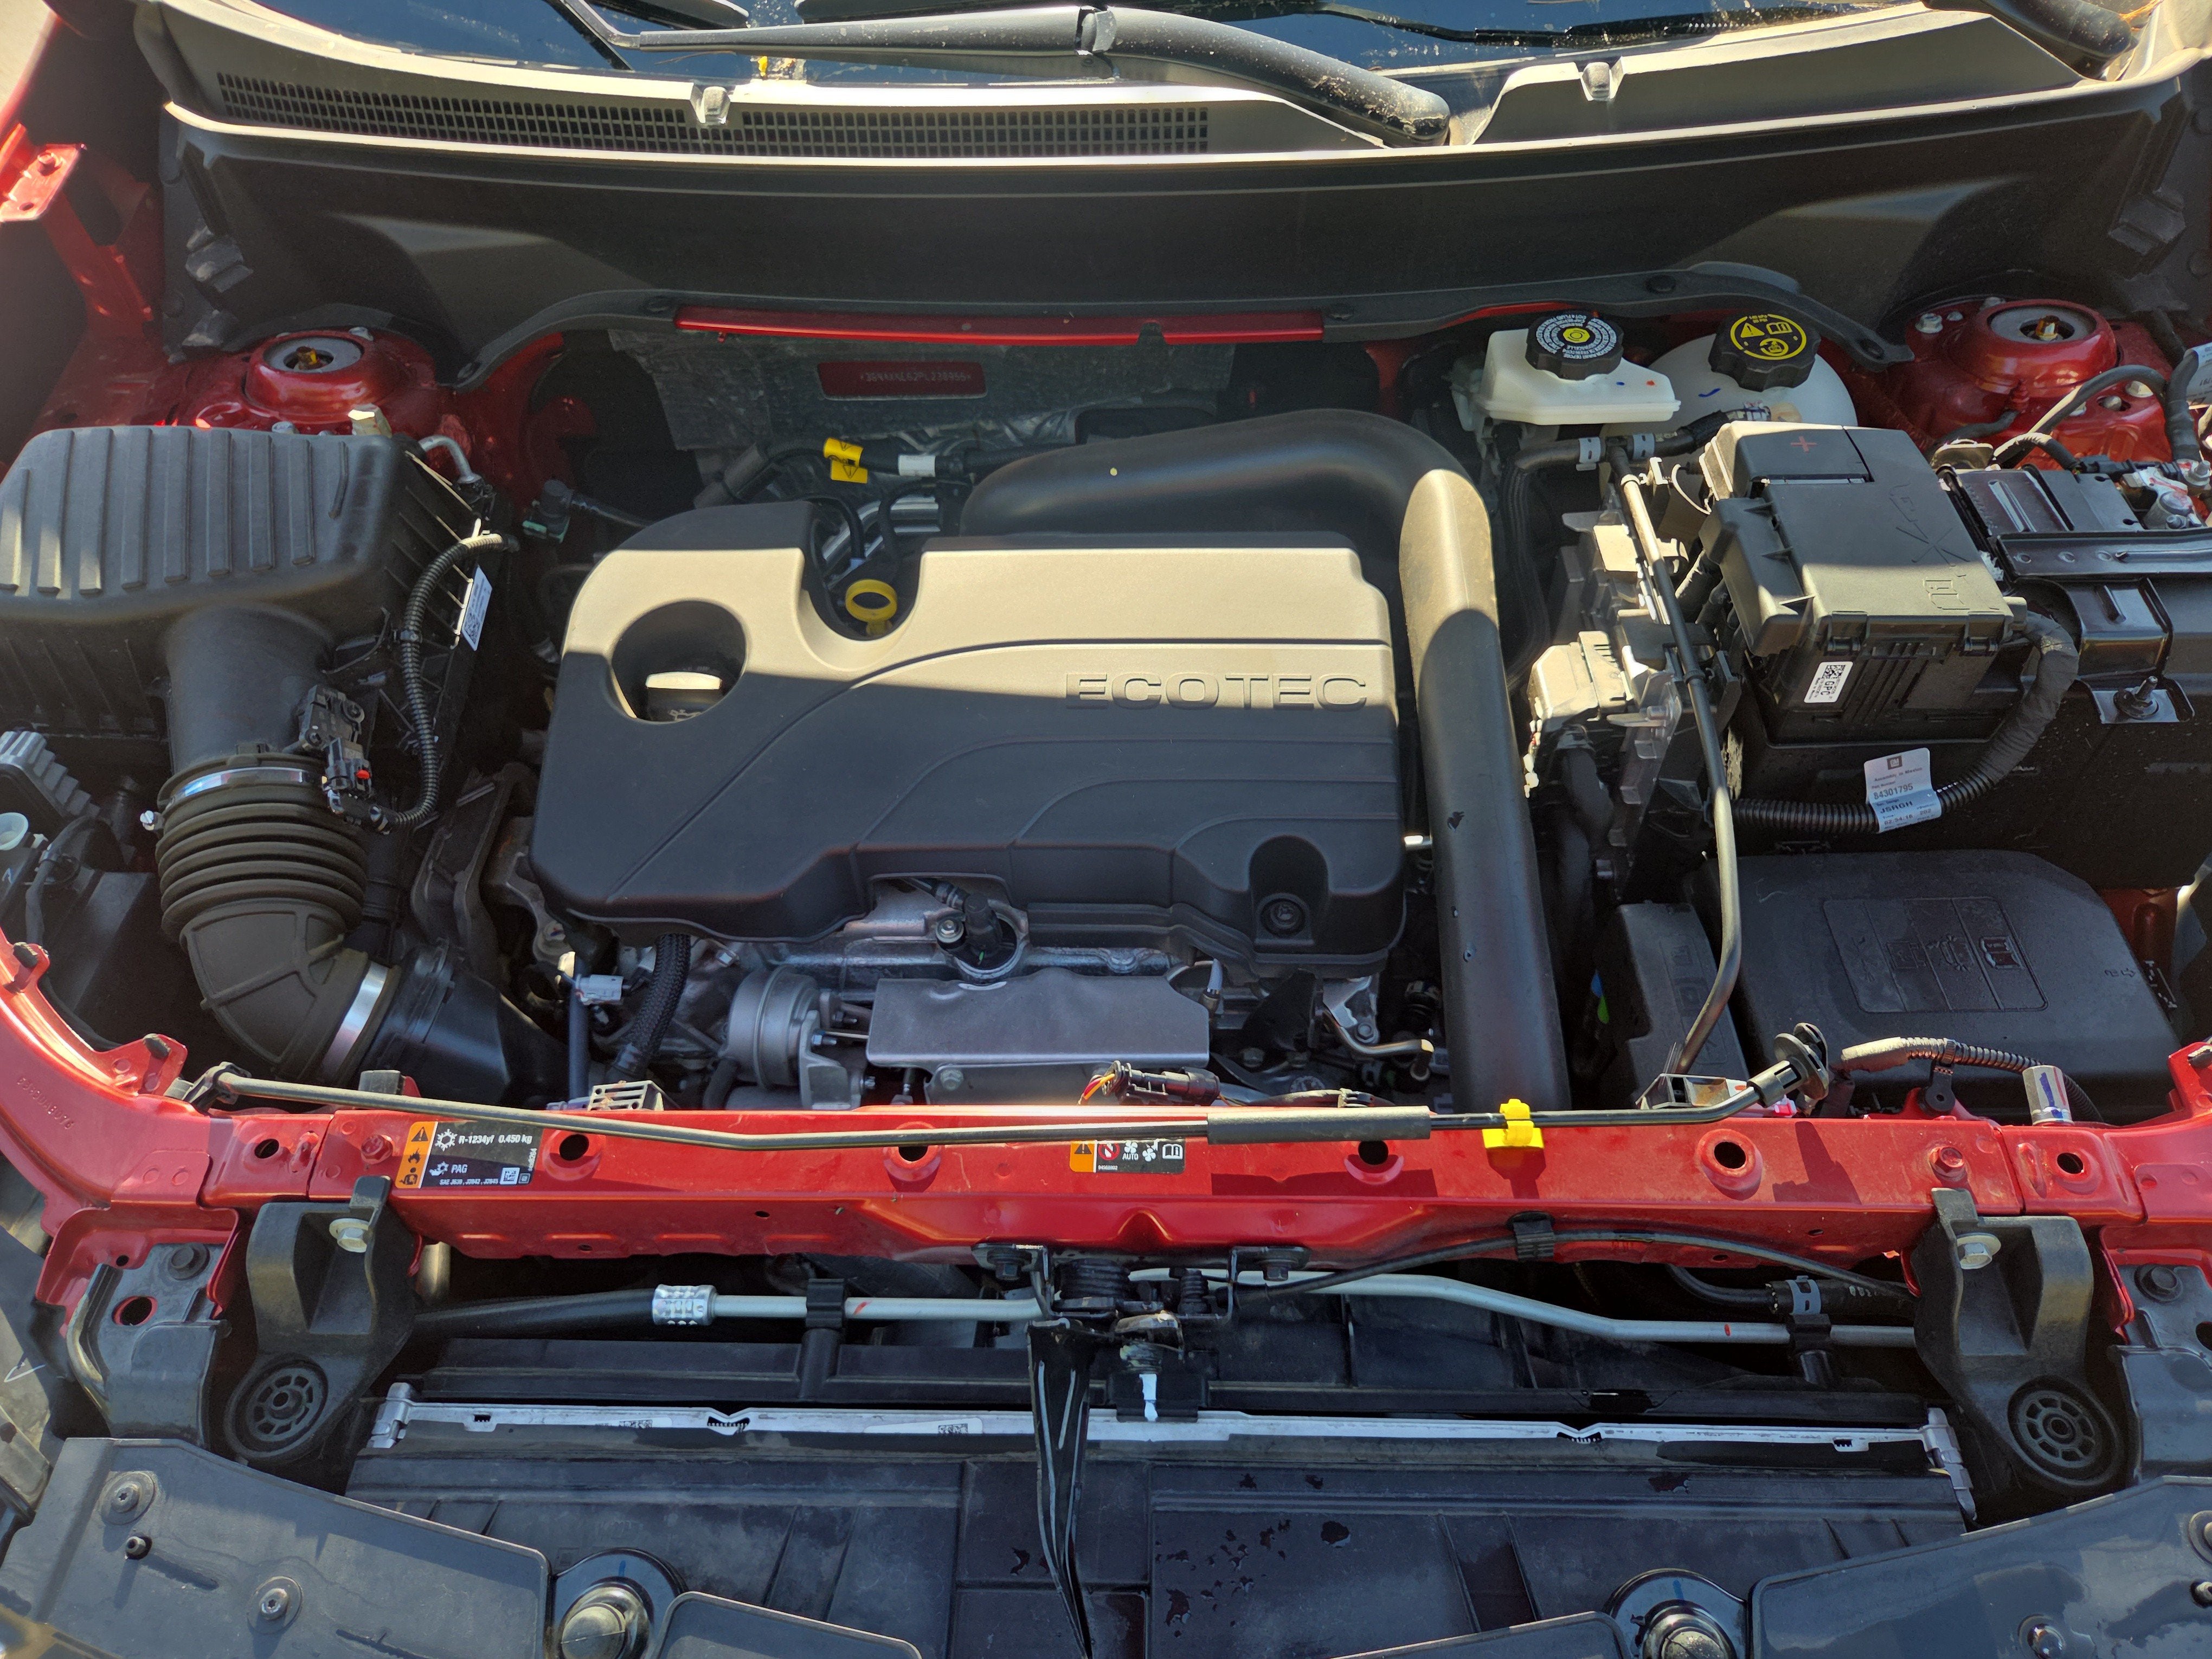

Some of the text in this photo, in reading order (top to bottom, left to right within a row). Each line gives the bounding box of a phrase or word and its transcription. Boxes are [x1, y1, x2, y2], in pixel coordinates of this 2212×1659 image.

[1065, 673, 1367, 711] ECOTEC
[1819, 681, 1835, 695] GPC
[458, 1134, 533, 1146] R-1234yf 0.450 kg
[451, 1164, 468, 1174] PAG
